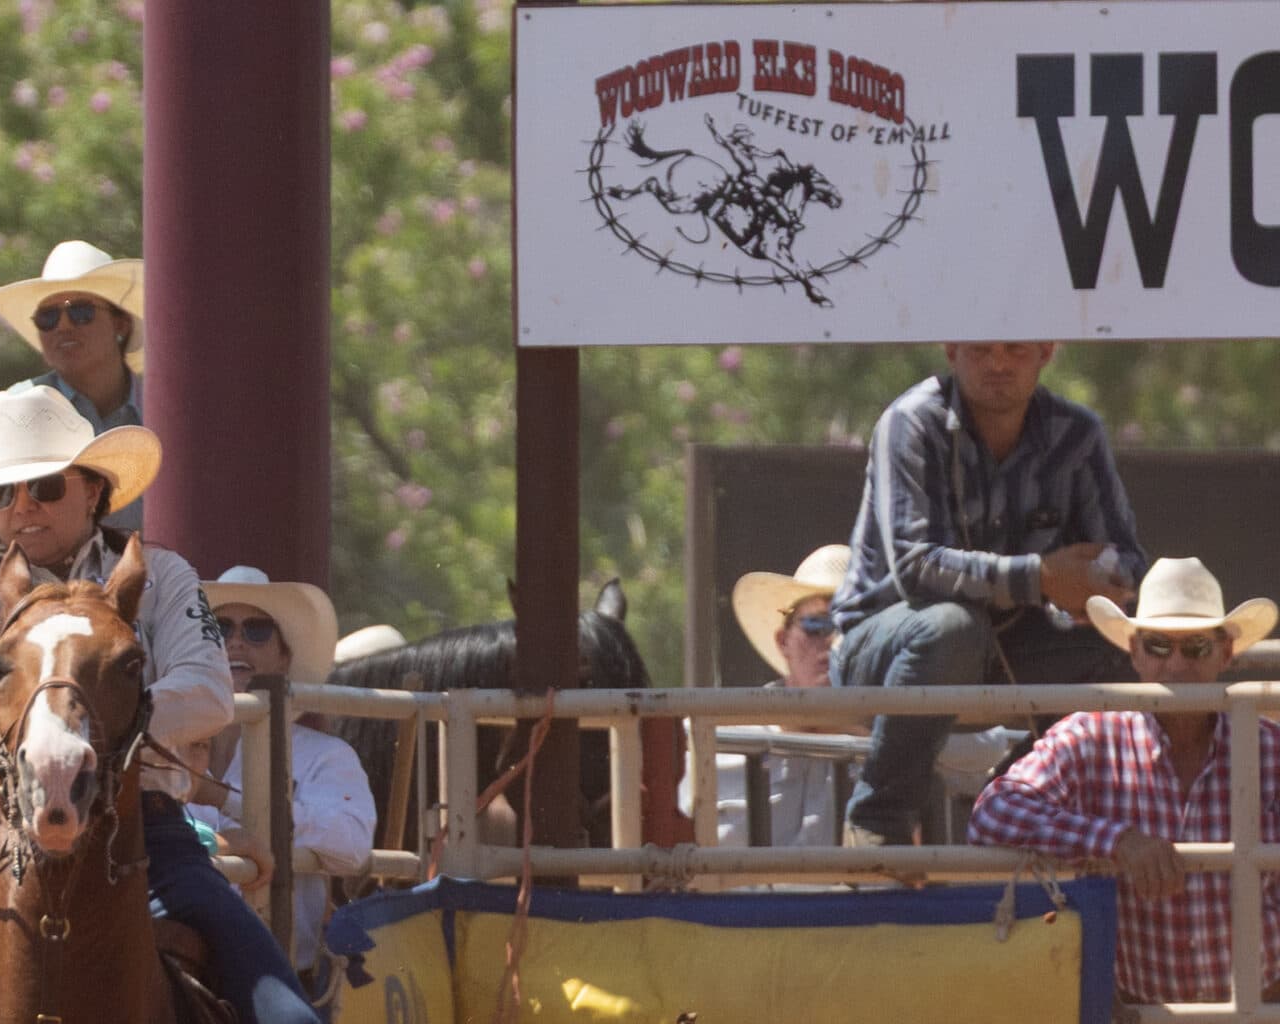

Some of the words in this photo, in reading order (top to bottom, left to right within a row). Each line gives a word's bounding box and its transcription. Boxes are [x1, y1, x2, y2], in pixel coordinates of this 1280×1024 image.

[595, 40, 741, 128] WOODWARD
[752, 38, 817, 97] ELKS
[828, 48, 906, 126] RODEO
[736, 92, 823, 138] TUFFEST
[831, 123, 858, 143] OF
[913, 121, 952, 143] ALL
